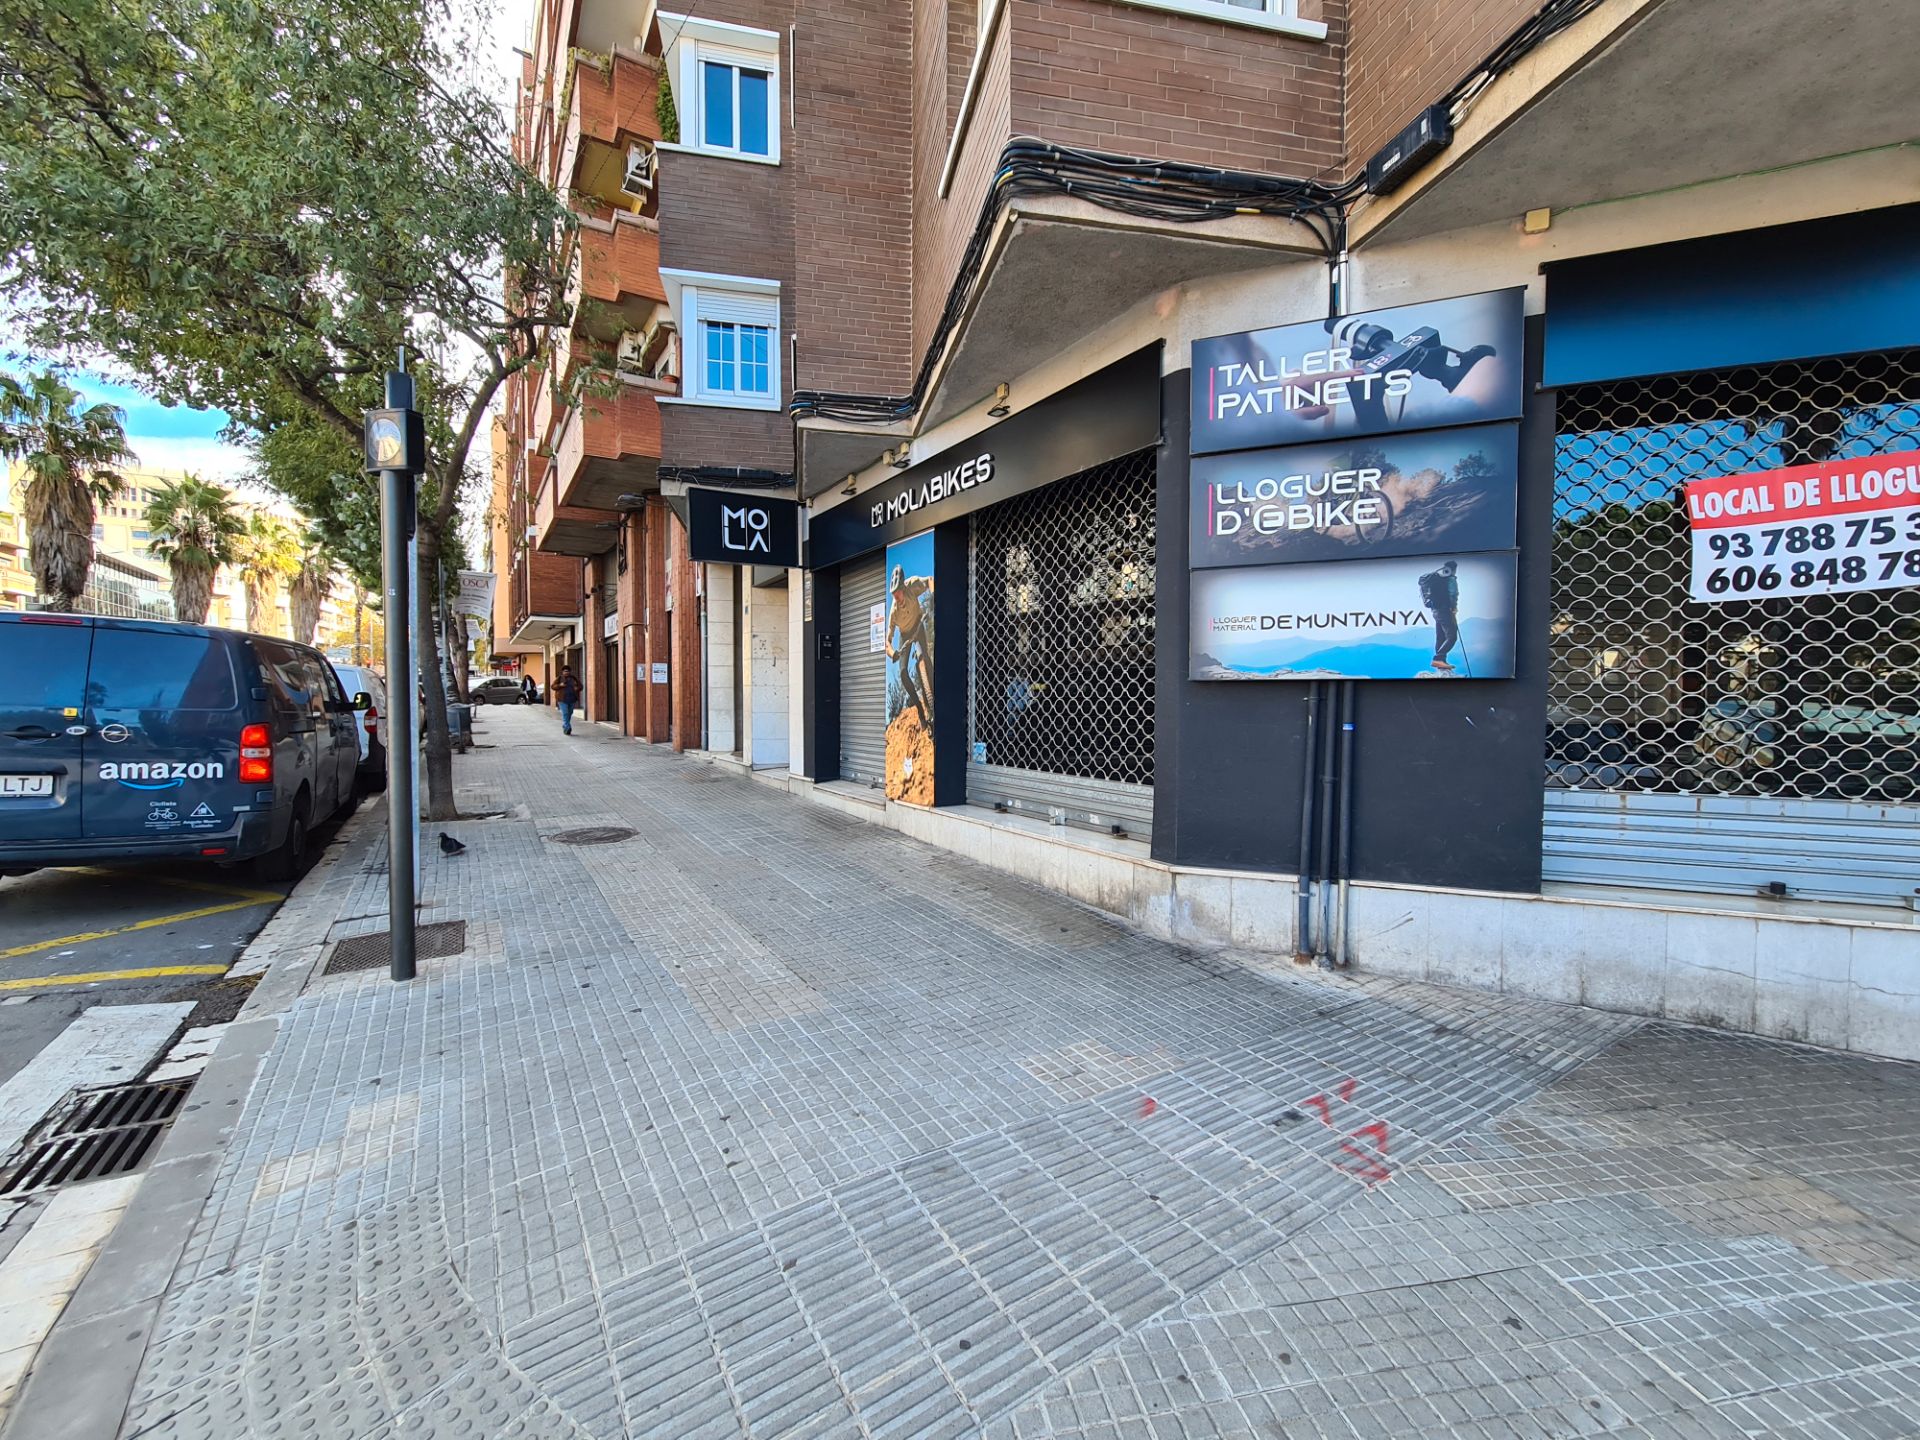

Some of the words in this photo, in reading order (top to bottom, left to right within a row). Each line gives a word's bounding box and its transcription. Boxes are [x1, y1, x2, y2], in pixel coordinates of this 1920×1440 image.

[1218, 347, 1352, 388] TALLER
[1217, 368, 1413, 420] PATINETS
[887, 453, 991, 521] MOLABIKES
[1216, 468, 1382, 505] LLOGUER
[1689, 486, 1774, 520] LOCAL
[1784, 478, 1821, 510] DE
[1708, 532, 1754, 560] 93
[1761, 523, 1835, 556] 788
[1845, 515, 1896, 549] 75
[1706, 564, 1782, 594] 606
[1790, 556, 1867, 589] 848
[1213, 615, 1257, 624] LLOGUER
[1213, 623, 1257, 632] MATERIAL
[1260, 614, 1293, 630] DE
[1296, 610, 1429, 629] MUNTANYA
[4, 777, 43, 792] LTJ
[100, 762, 223, 780] amazon
